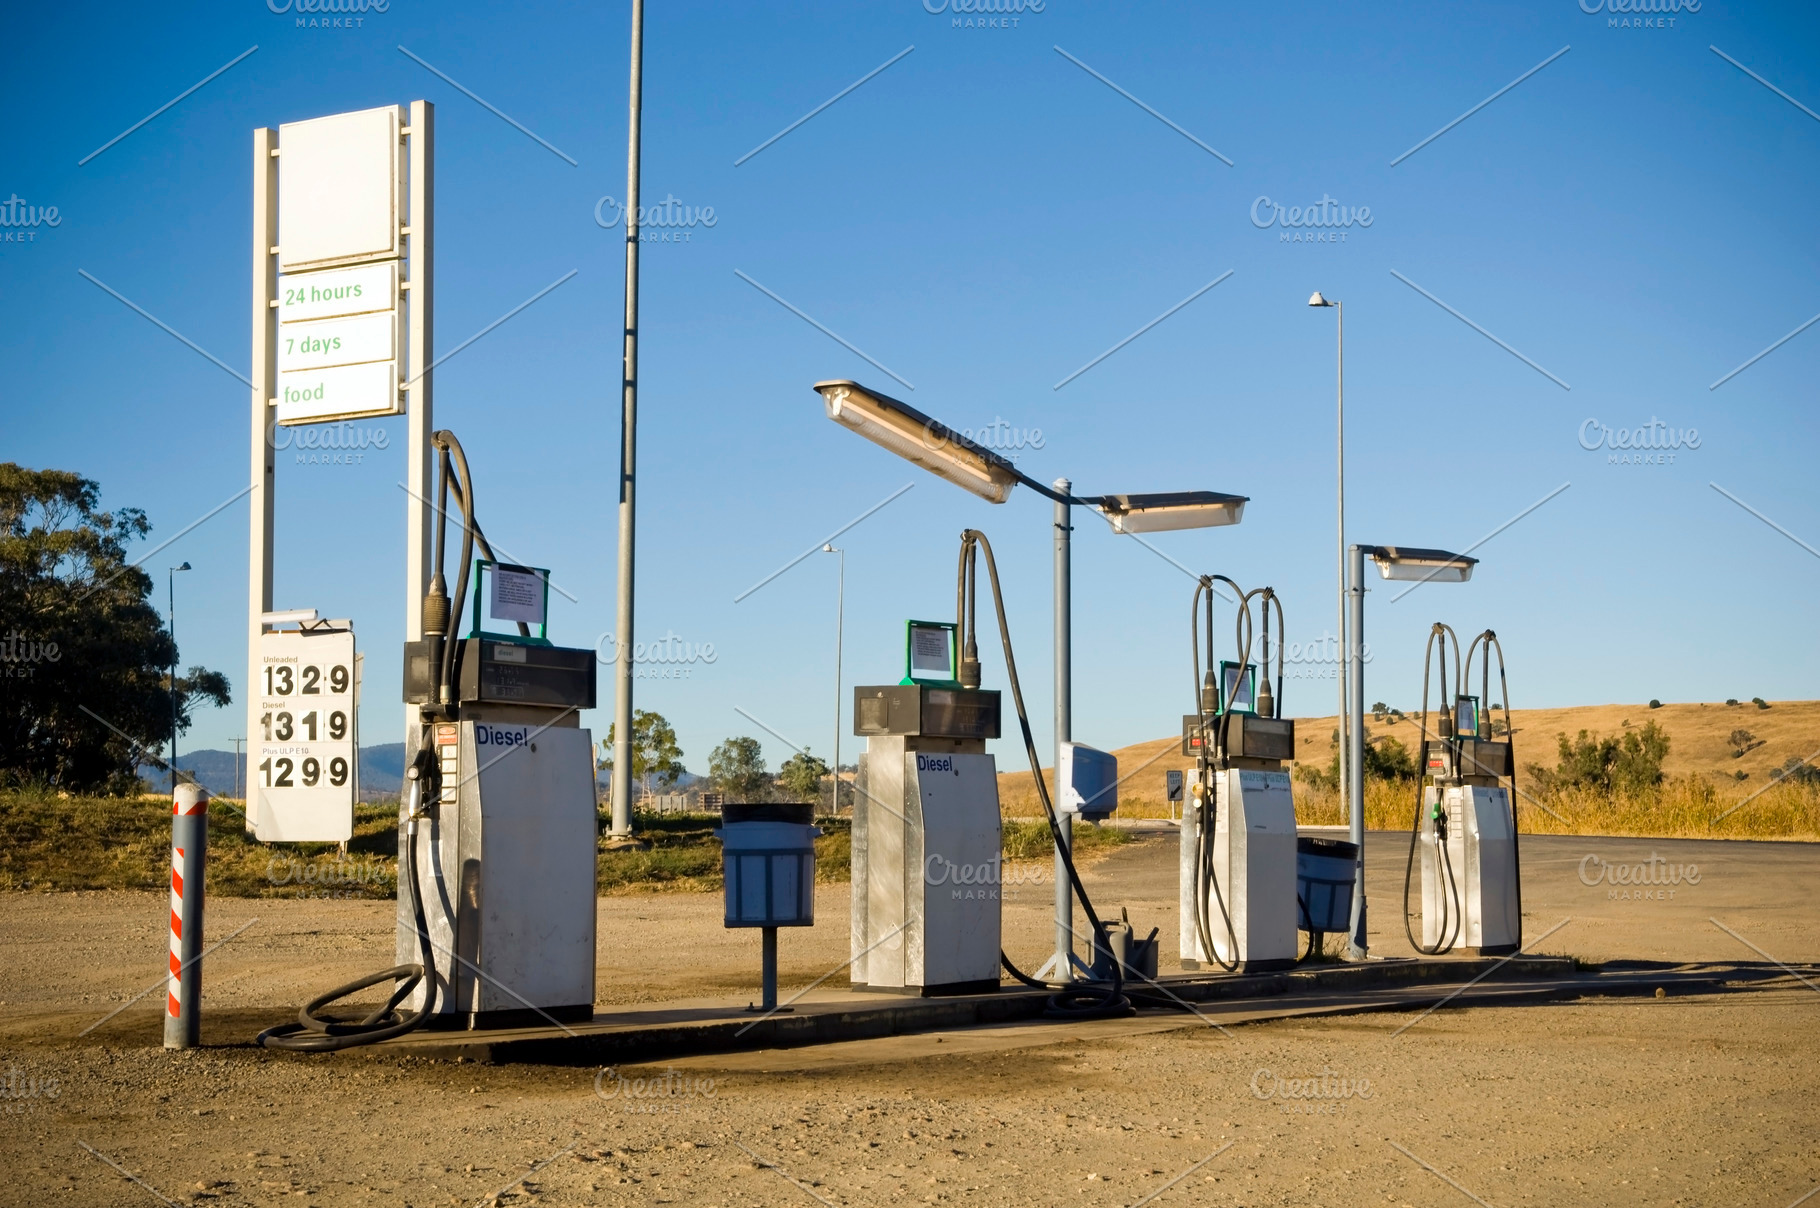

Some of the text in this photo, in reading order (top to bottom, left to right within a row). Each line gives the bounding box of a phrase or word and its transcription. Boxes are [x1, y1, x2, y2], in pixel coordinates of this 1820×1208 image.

[285, 284, 363, 306] 24 hours
[286, 335, 342, 355] 7 days
[283, 382, 325, 404] food
[262, 701, 286, 709] Diesel
[476, 725, 528, 746] Diesel
[262, 747, 278, 755] Plus
[279, 747, 294, 755] ULP
[917, 755, 953, 771] Diesel
